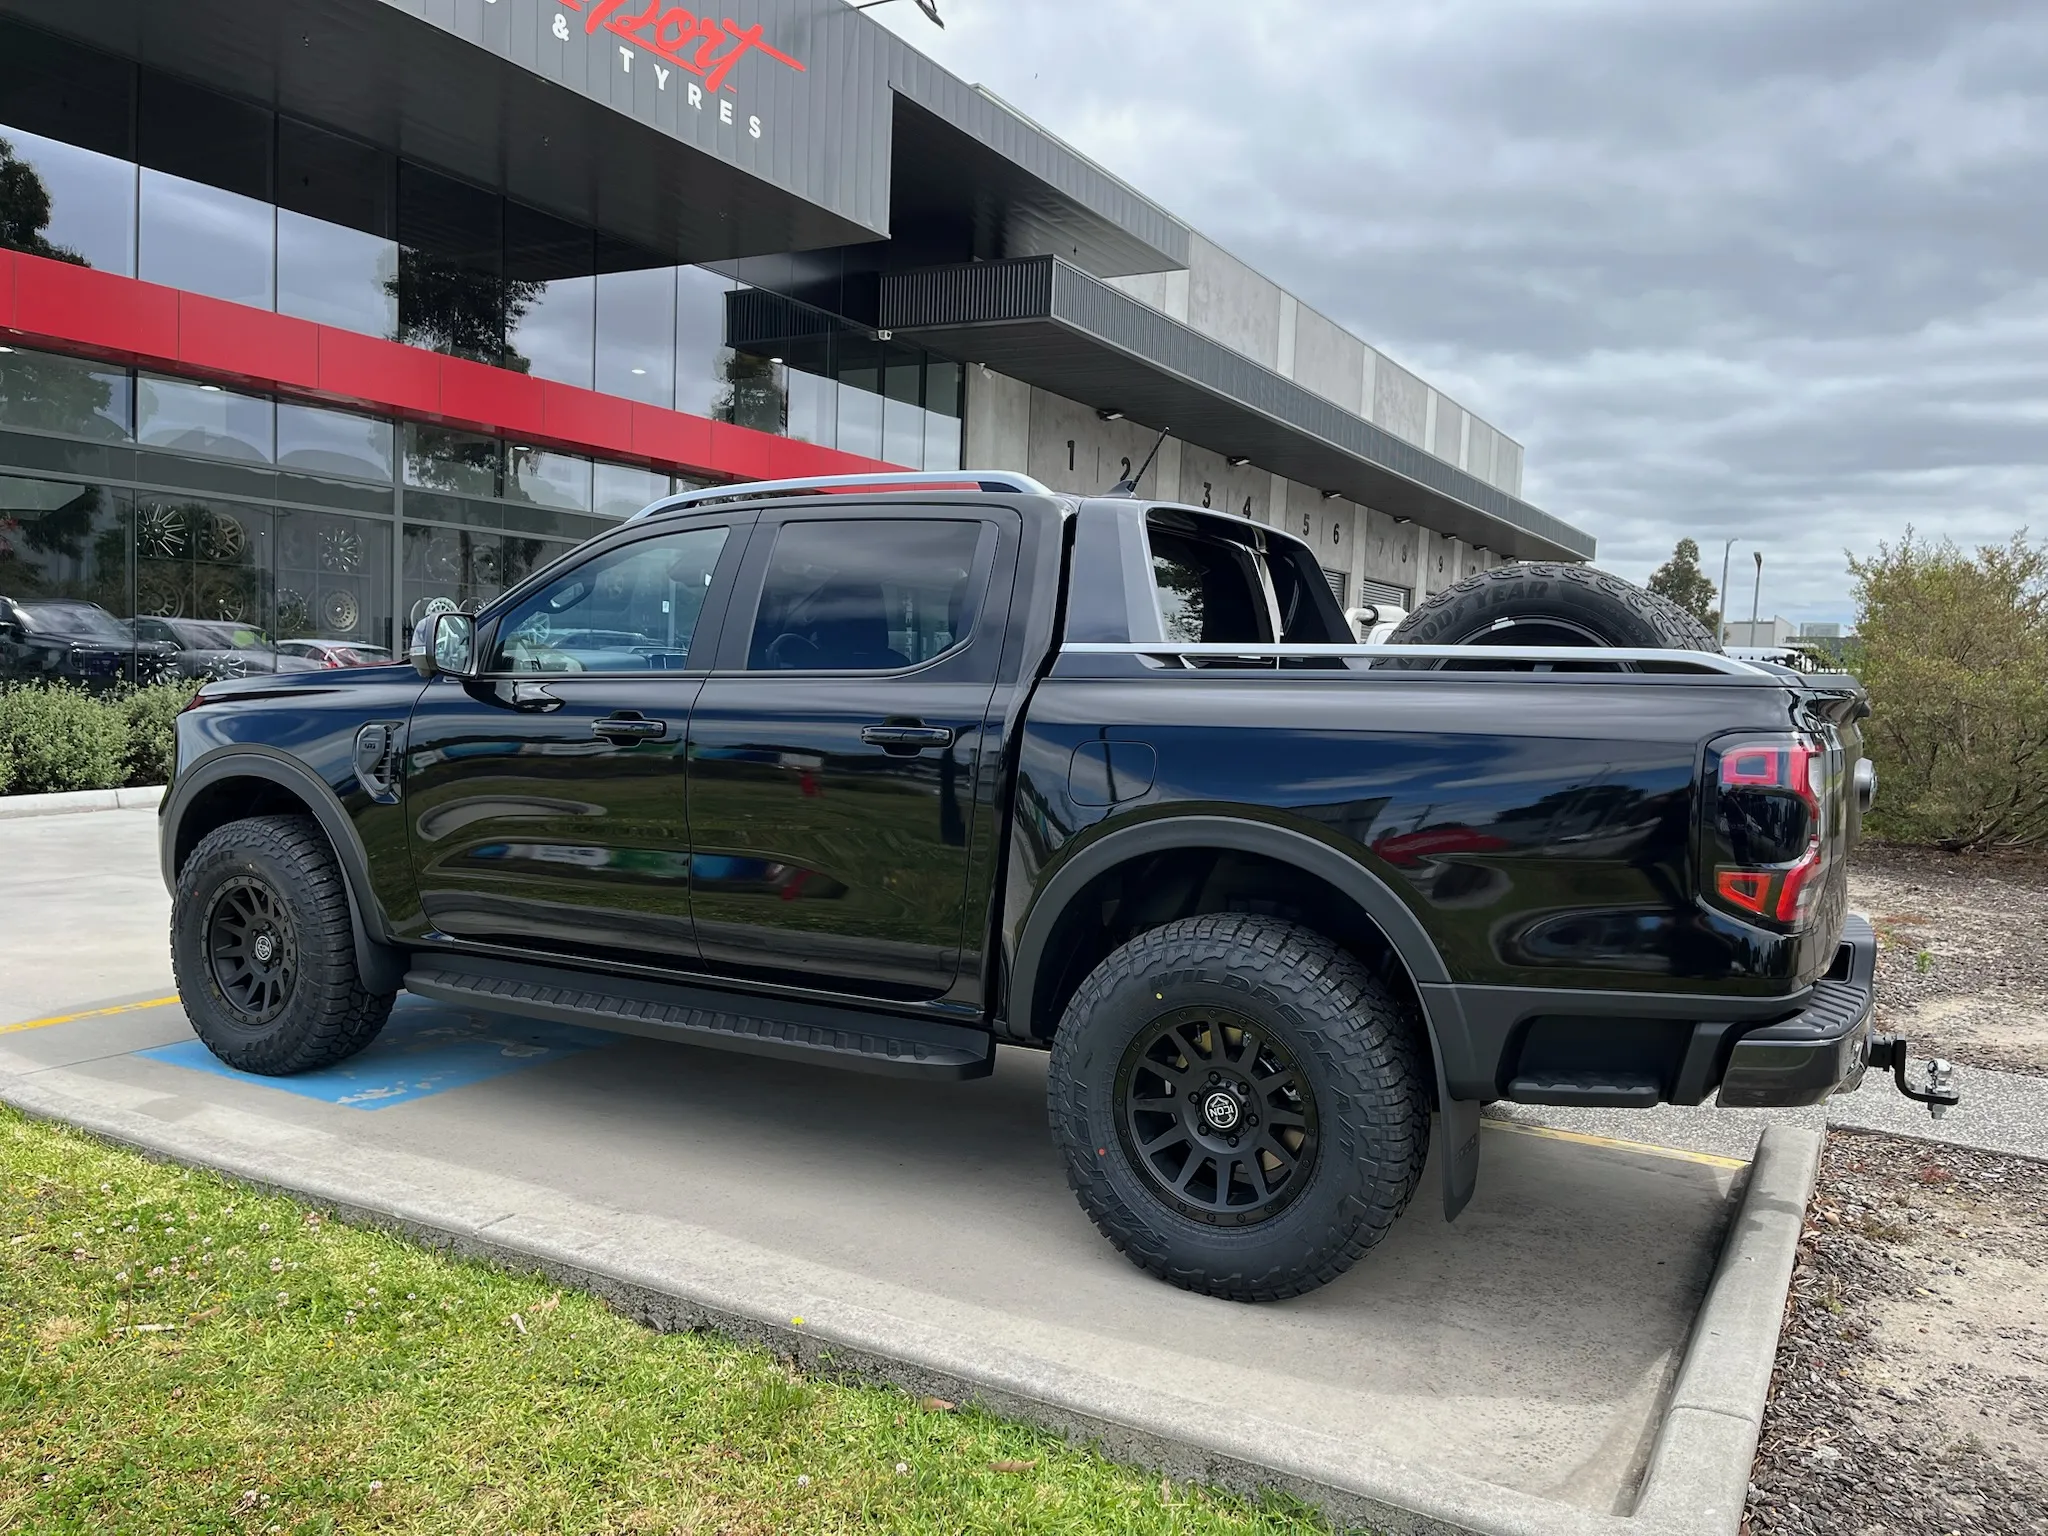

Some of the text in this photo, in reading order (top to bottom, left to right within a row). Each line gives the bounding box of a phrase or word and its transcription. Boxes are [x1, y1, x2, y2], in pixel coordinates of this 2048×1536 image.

[552, 13, 761, 139] & TYRES
[1067, 440, 1075, 471] 1
[1120, 456, 1131, 482] 2
[1202, 481, 1212, 509] 3
[1242, 495, 1252, 519] 4
[1302, 512, 1310, 536] 5
[1333, 522, 1340, 545] 6
[1438, 555, 1444, 573] 9
[1149, 967, 1344, 1078] WILDPEAK
[1209, 1104, 1234, 1117] ICON
